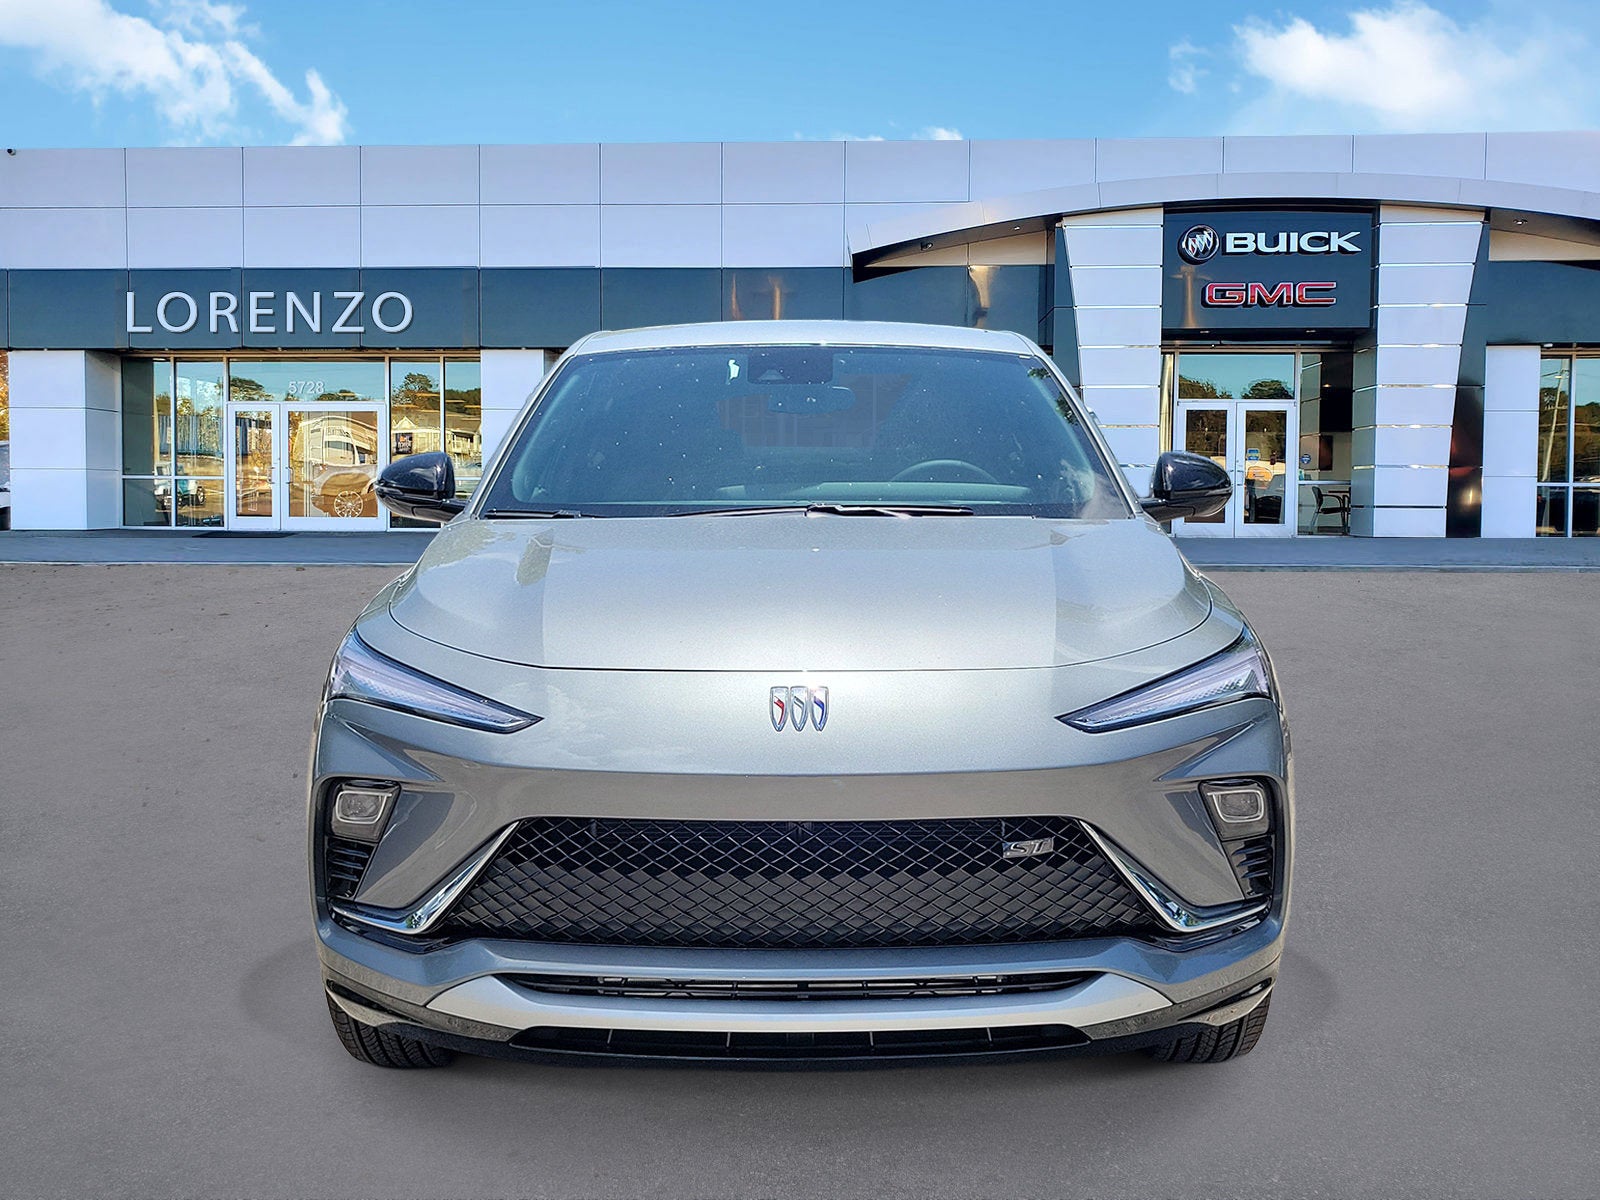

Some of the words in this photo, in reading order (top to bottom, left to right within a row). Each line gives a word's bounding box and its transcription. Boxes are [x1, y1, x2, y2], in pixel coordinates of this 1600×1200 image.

[1225, 231, 1362, 253] BUICK
[1205, 281, 1337, 306] GMC
[125, 291, 413, 333] LORENZO
[288, 380, 325, 394] 5728
[1009, 838, 1052, 856] ST
